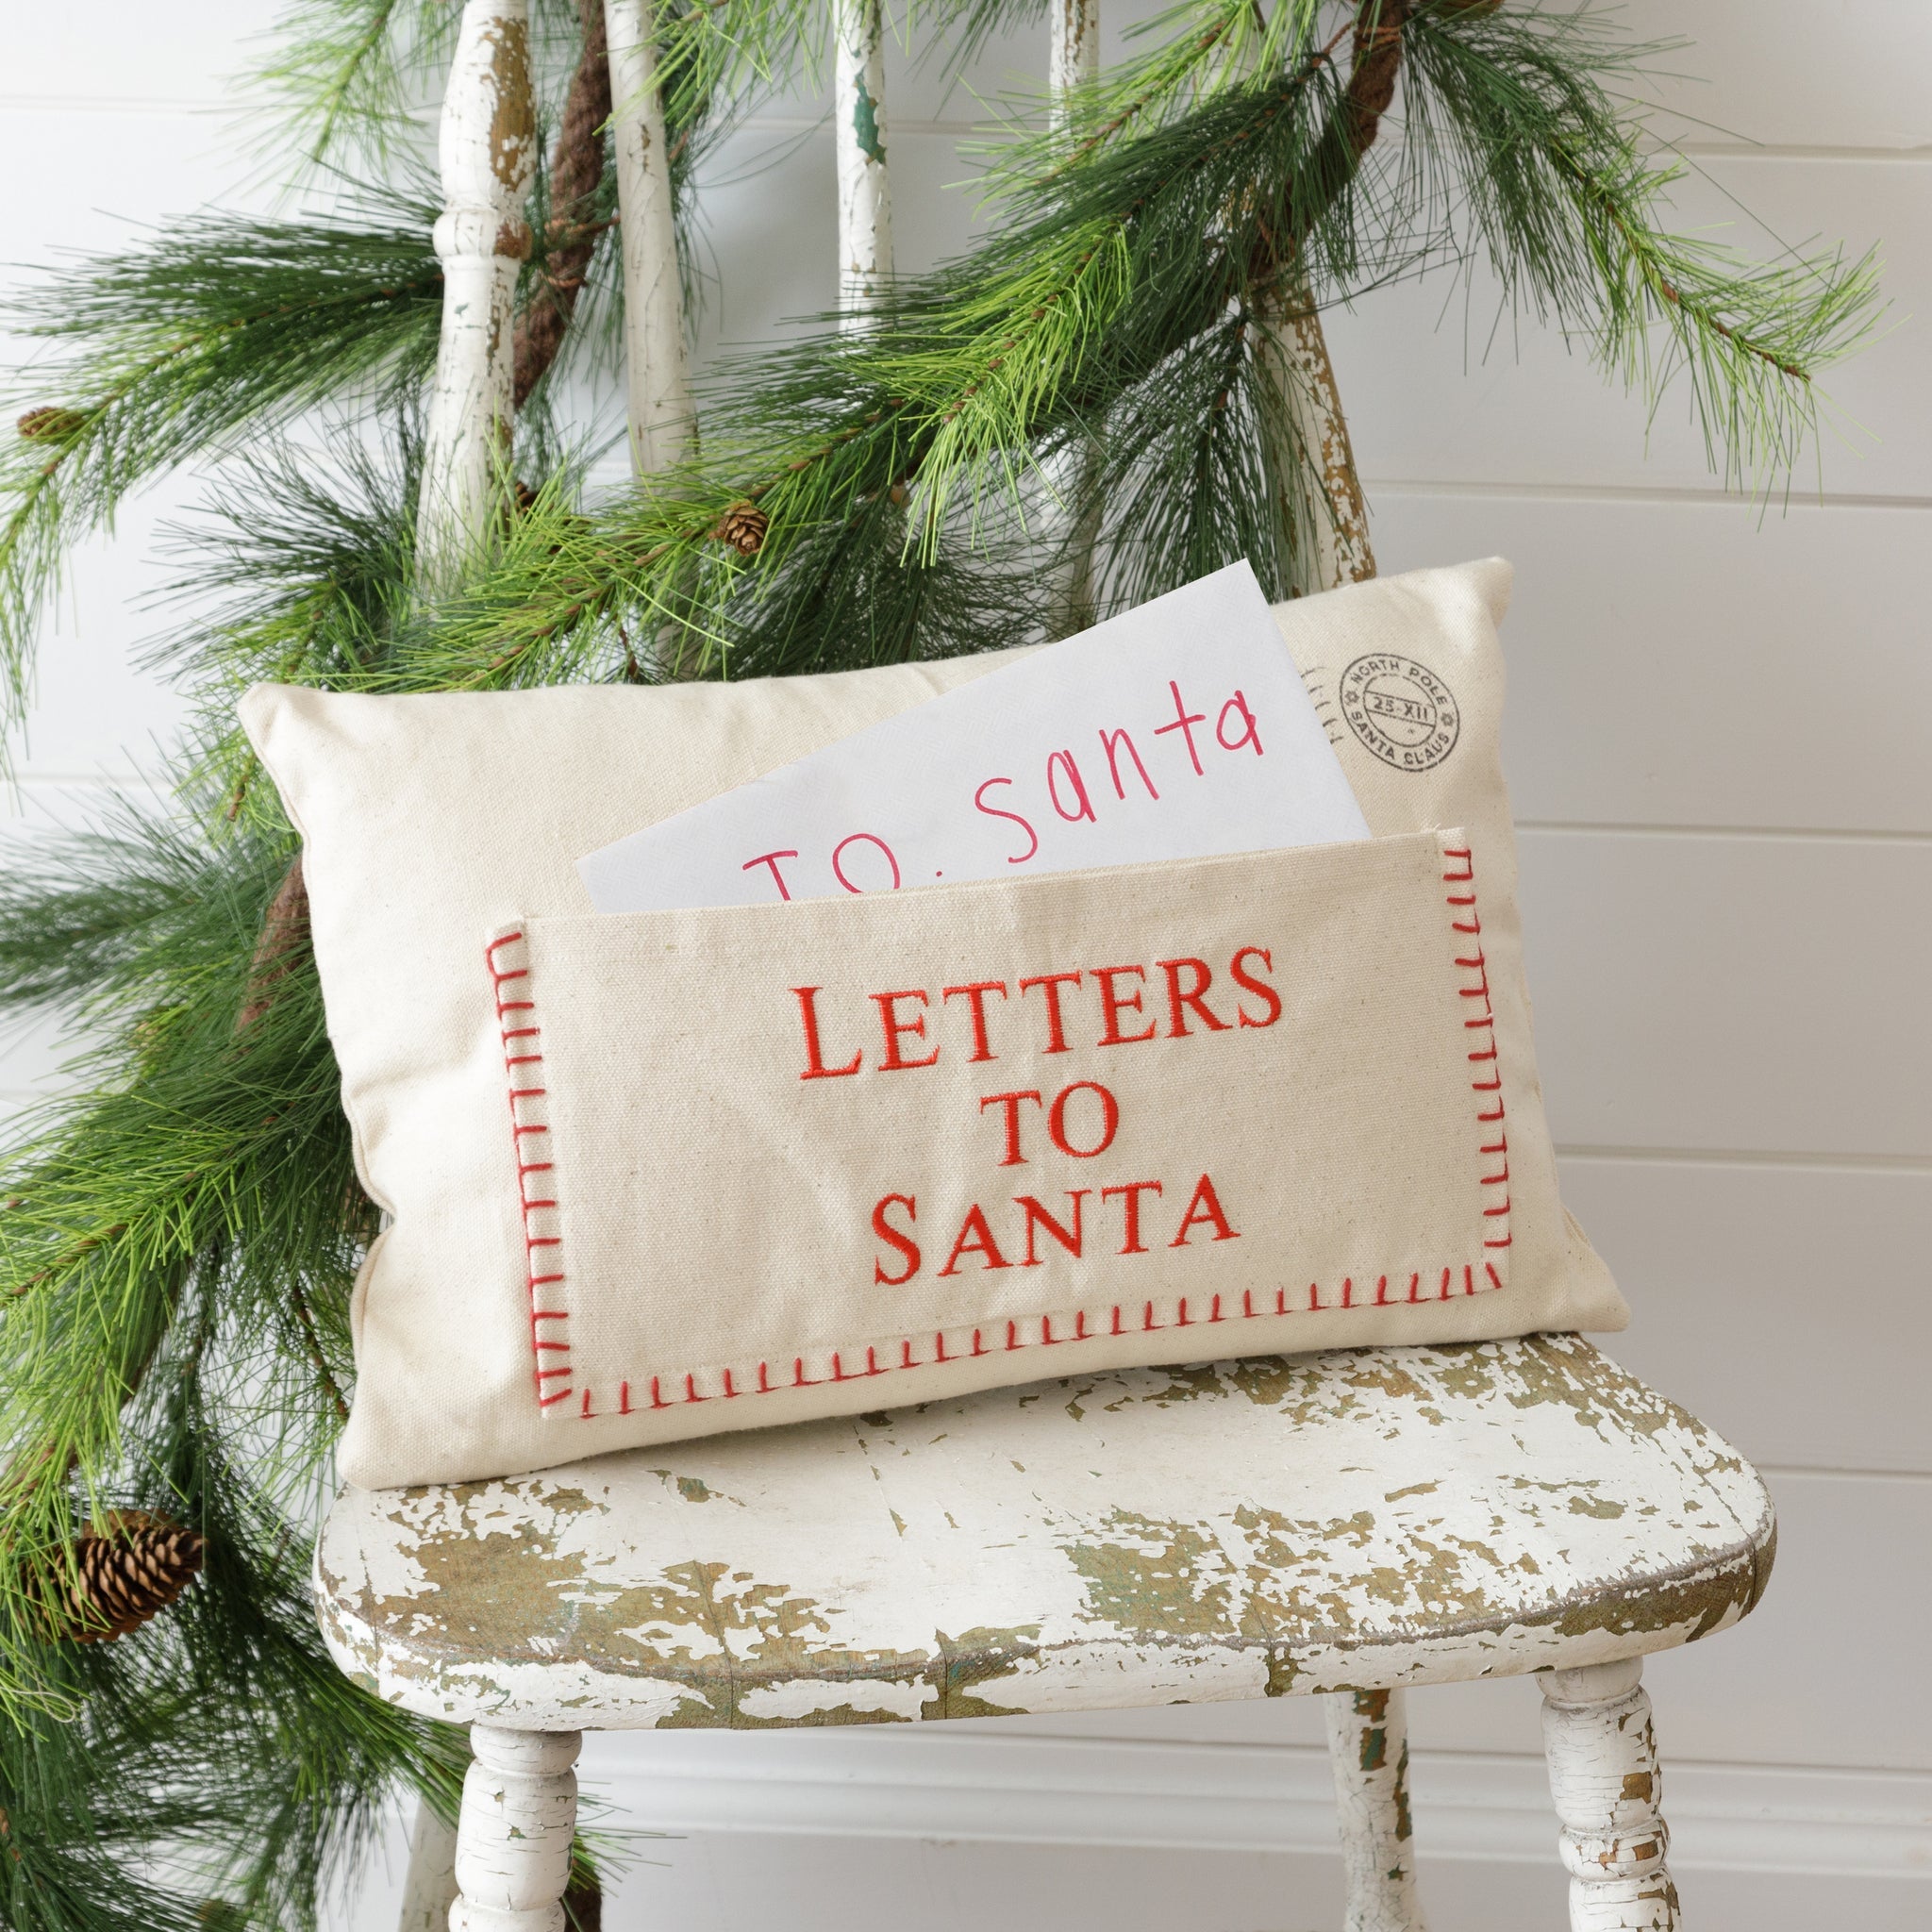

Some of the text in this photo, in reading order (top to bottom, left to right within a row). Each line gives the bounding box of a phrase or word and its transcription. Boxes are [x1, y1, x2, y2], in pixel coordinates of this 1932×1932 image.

[1350, 659, 1448, 706] NORTH POLE
[1351, 710, 1450, 765] SANTA CLAUS
[789, 945, 1283, 1080] LETTERS
[979, 1081, 1120, 1167] TO
[871, 1173, 1241, 1286] SANTA
